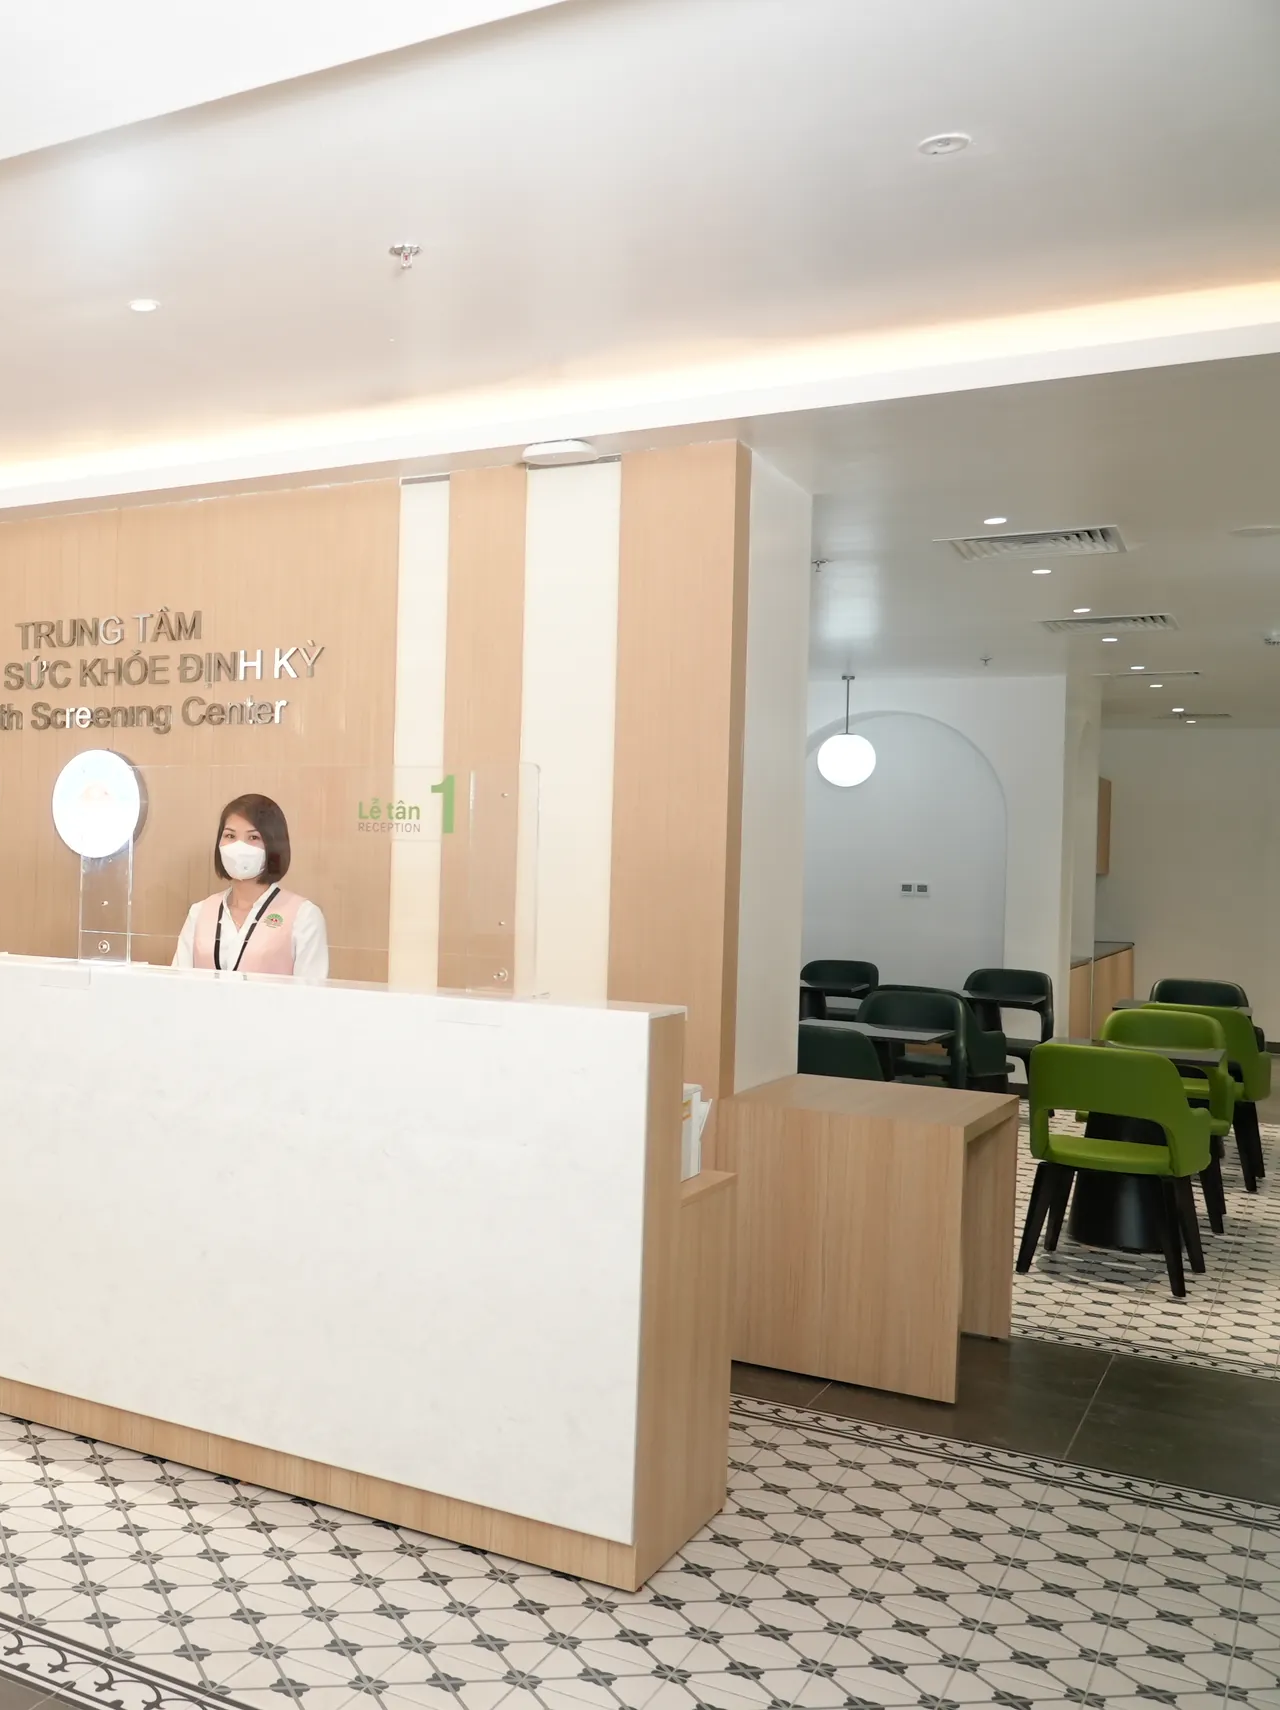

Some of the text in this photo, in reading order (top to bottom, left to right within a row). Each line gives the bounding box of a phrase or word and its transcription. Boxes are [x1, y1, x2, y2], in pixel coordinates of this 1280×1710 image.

[15, 606, 202, 650] TRUNG TÂM
[4, 655, 71, 690] SỨC
[79, 649, 170, 687] KHỎE
[177, 649, 263, 689] ĐỊNH
[273, 639, 325, 680] KỲ
[30, 700, 172, 735] Screening
[181, 695, 288, 727] Center
[358, 774, 455, 835] Lễ tân 1
[357, 822, 421, 833] RECEPTION
